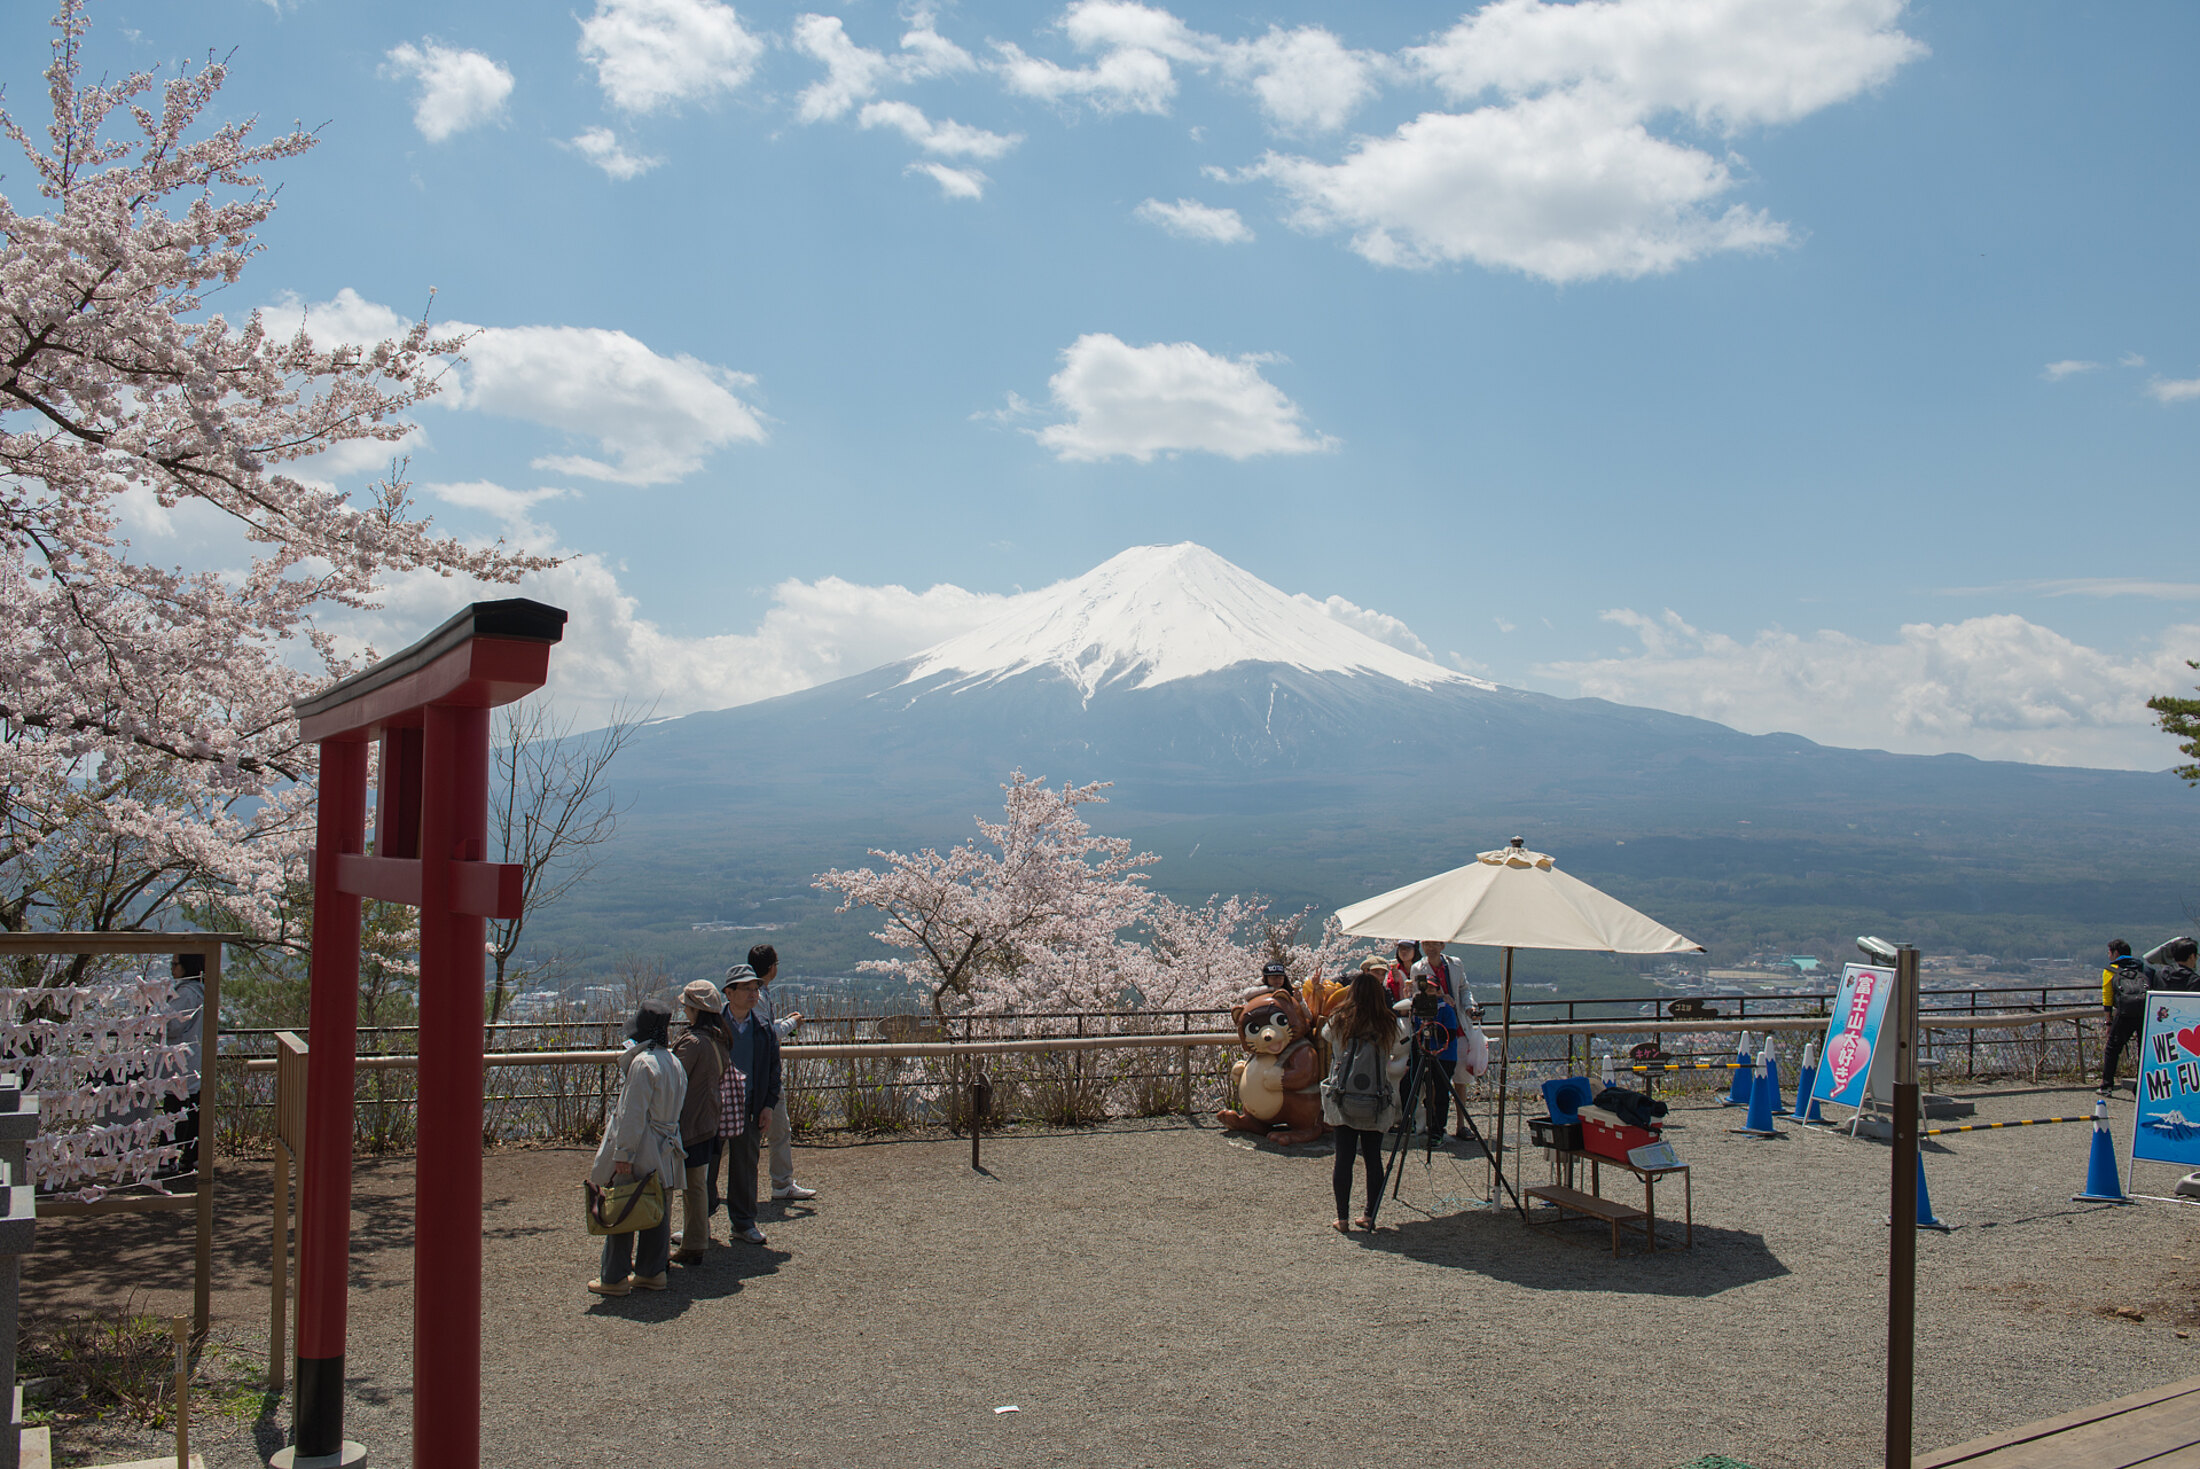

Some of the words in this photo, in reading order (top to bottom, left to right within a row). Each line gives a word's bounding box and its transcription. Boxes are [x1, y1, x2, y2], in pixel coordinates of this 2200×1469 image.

[1636, 1048, 1660, 1059] キケン
[2152, 1031, 2179, 1064] WE
